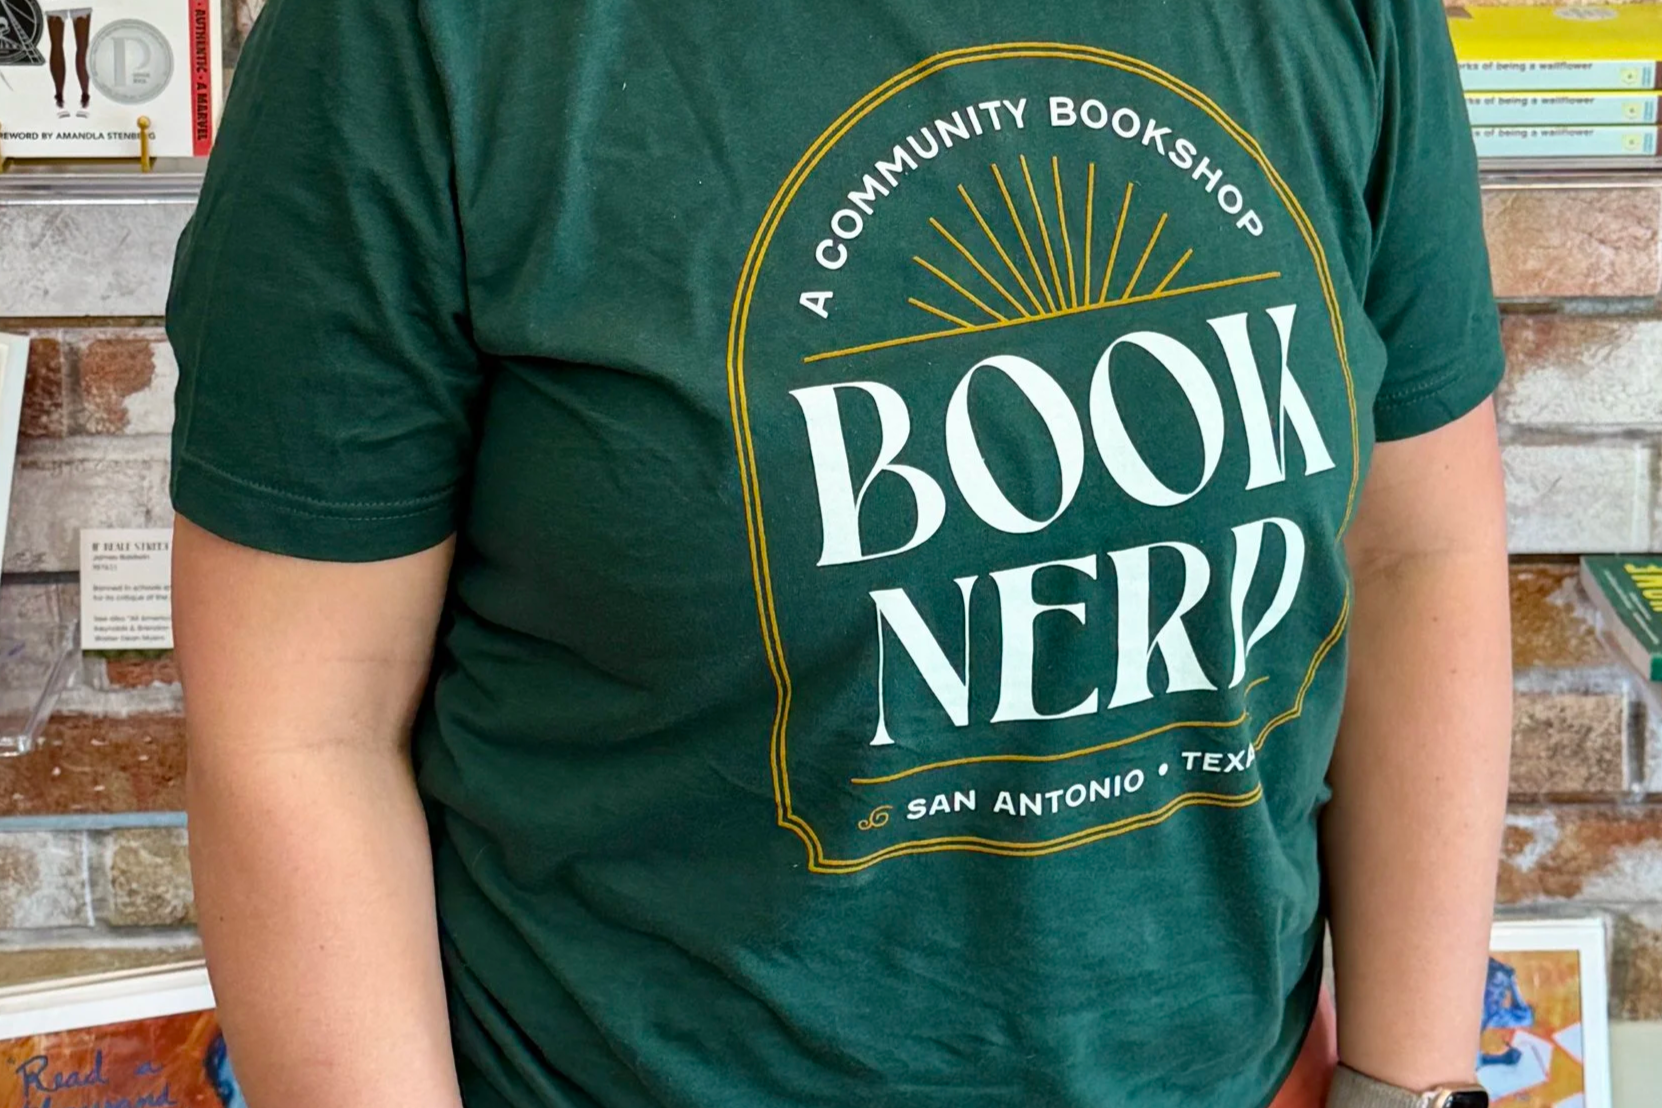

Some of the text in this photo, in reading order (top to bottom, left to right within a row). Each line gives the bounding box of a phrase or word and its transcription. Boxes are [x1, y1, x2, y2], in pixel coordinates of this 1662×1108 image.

[195, 9, 208, 74] AUTHENTIC
[197, 82, 207, 91] A
[1481, 62, 1493, 71] of
[1496, 62, 1526, 72] being
[1529, 62, 1536, 71] a
[1539, 62, 1593, 71] wallflower
[197, 93, 209, 141] MARVEL
[1498, 97, 1528, 107] being
[41, 132, 53, 141] BY
[56, 132, 105, 141] AMANDLA
[1498, 129, 1528, 139] being
[799, 96, 1264, 319] A COMMUNITY BOOKSHOP
[788, 303, 1336, 568] BOOK
[868, 516, 1306, 746] NERD
[906, 790, 976, 820] SAN
[993, 768, 1145, 817] ANTONIO
[16, 1049, 109, 1097] Read
[134, 1060, 164, 1075] a
